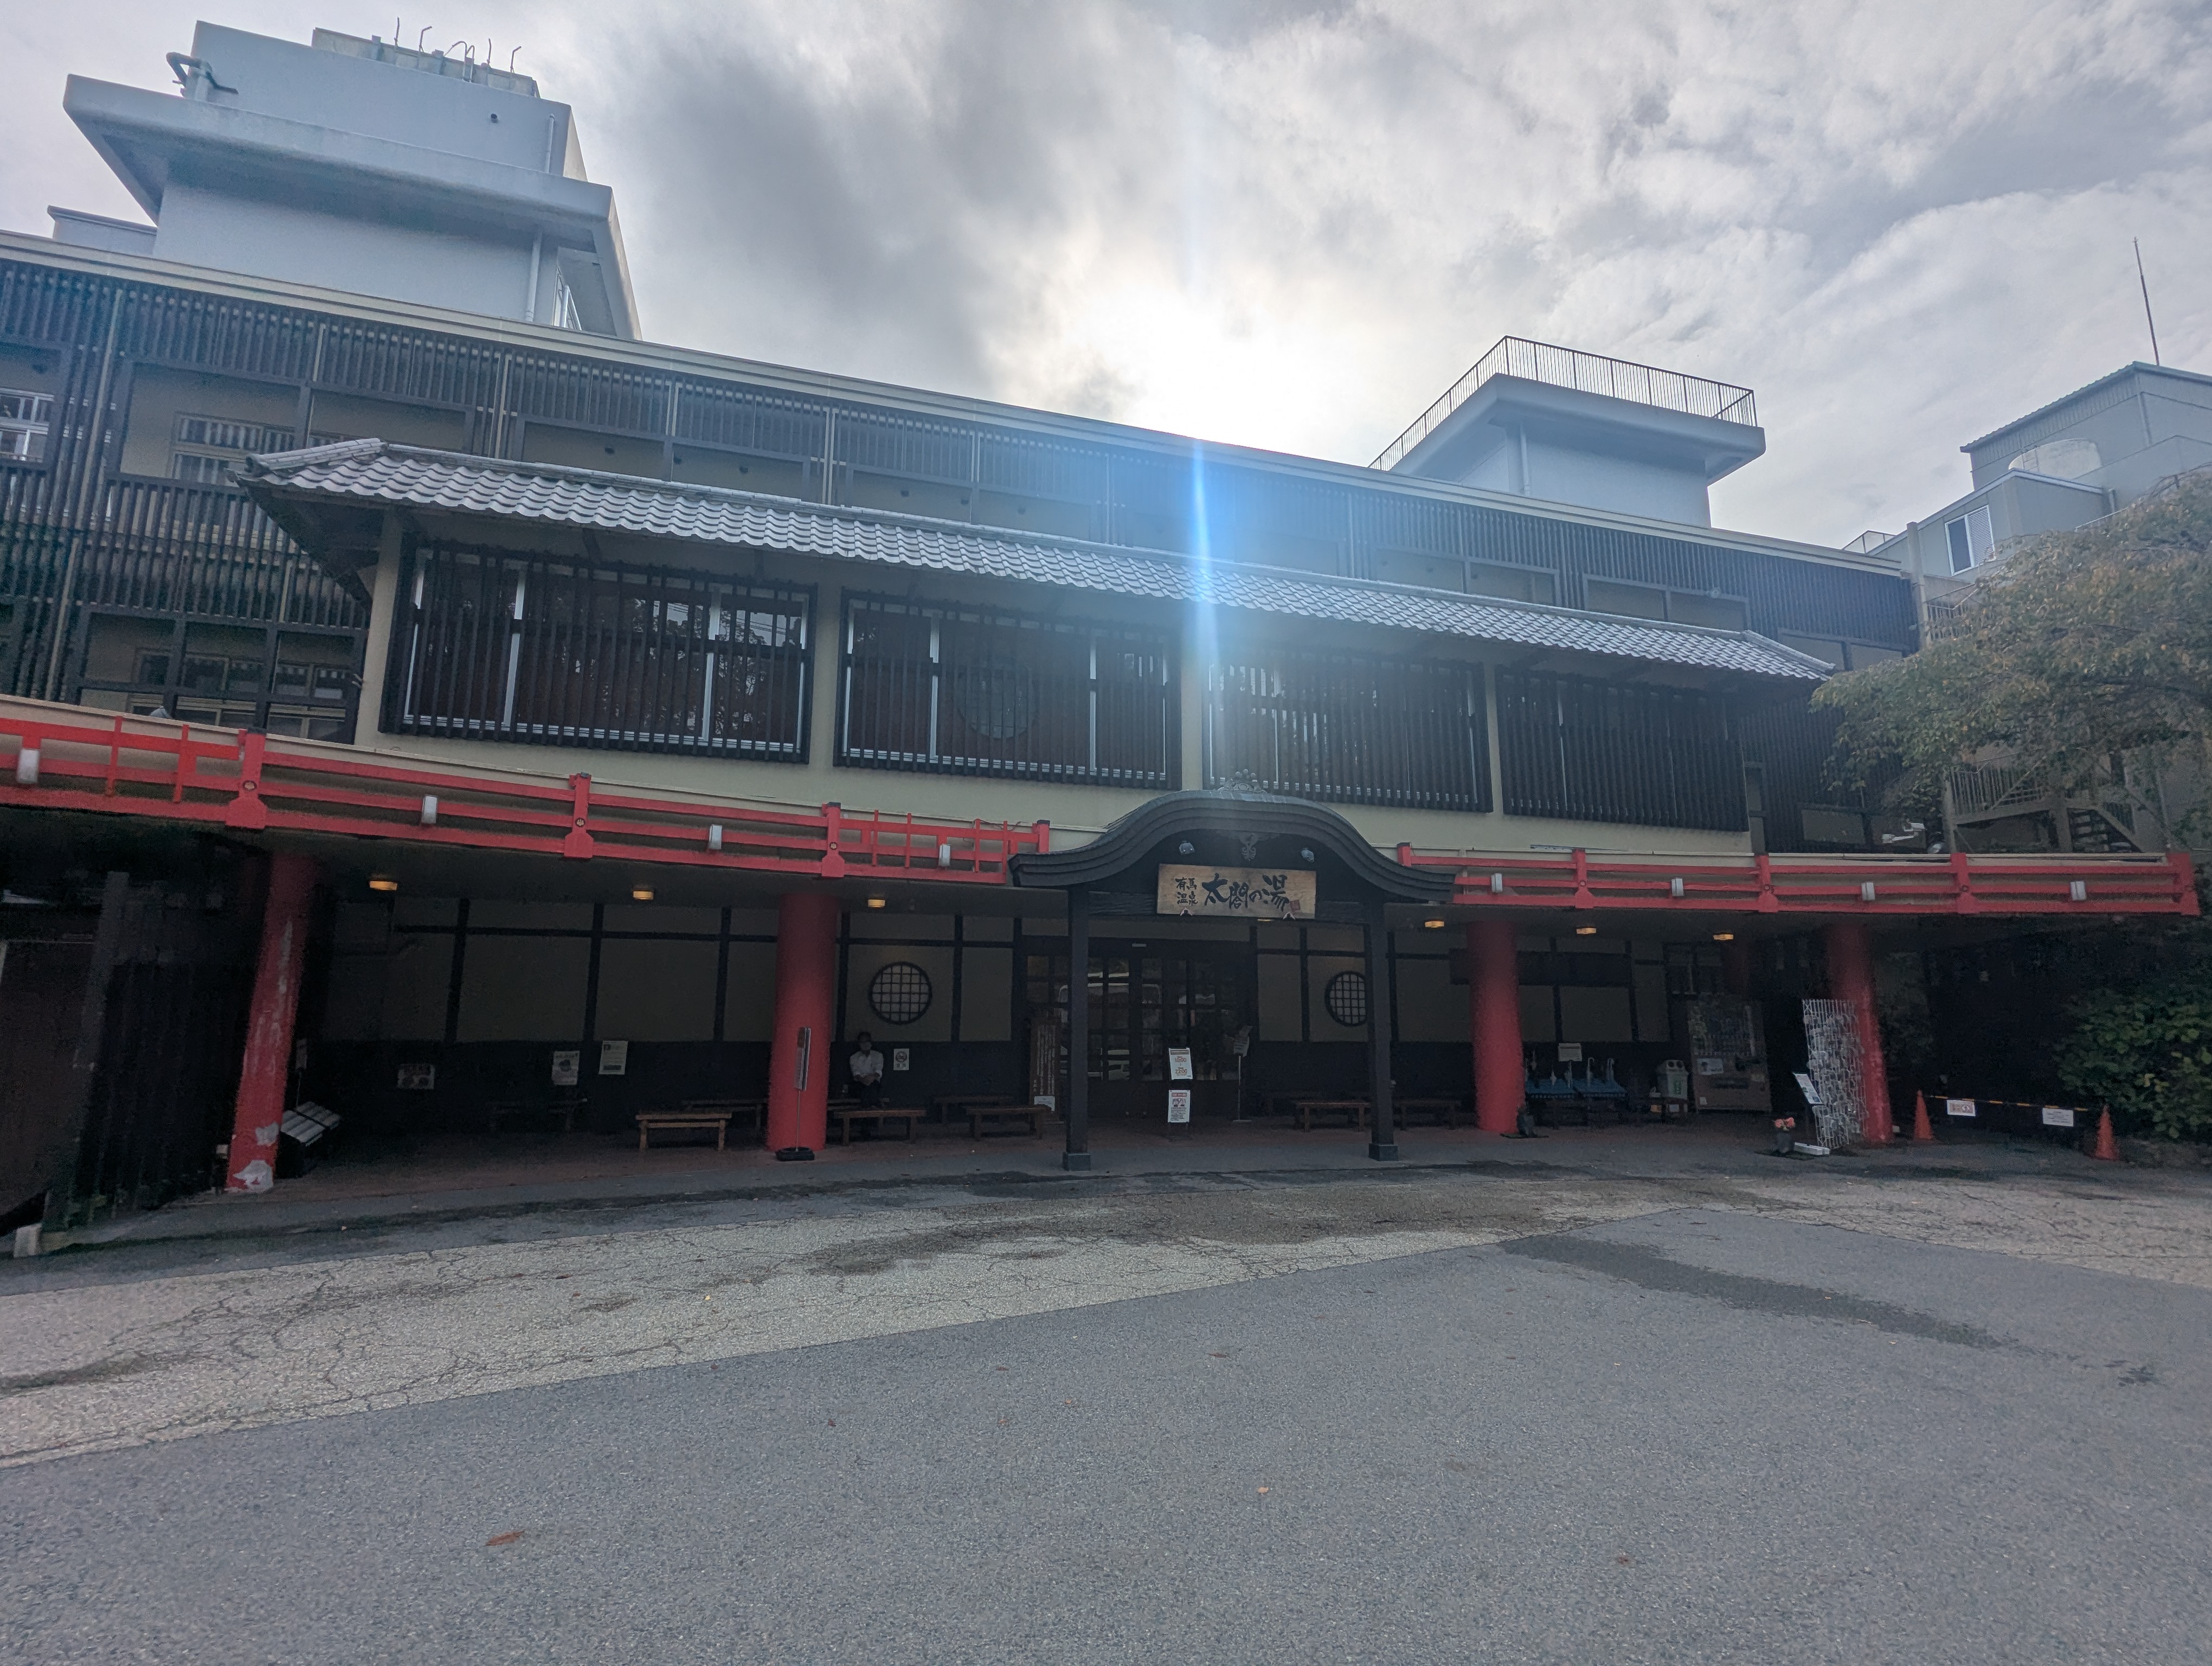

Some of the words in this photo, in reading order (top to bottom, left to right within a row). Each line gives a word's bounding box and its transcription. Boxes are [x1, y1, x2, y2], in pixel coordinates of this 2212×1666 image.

[1175, 877, 1197, 890] 有馬
[1176, 891, 1198, 906] 温泉
[1202, 873, 1290, 912] 太閤の湯
